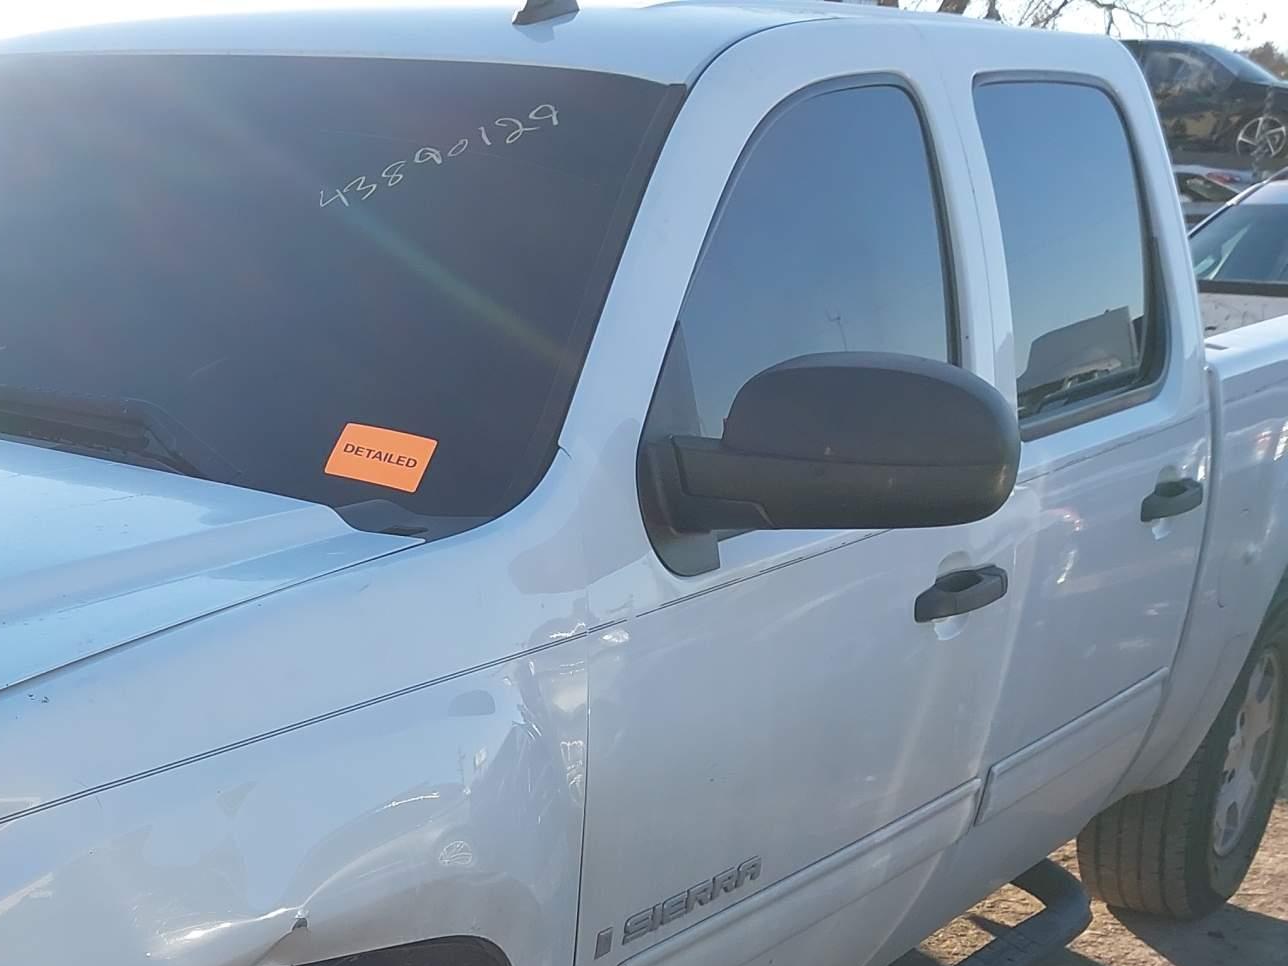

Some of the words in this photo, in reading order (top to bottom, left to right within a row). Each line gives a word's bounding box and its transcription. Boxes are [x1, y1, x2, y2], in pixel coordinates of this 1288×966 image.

[319, 103, 560, 207] 43890129
[343, 442, 418, 469] DETAILED
[622, 855, 762, 945] SIERRA
